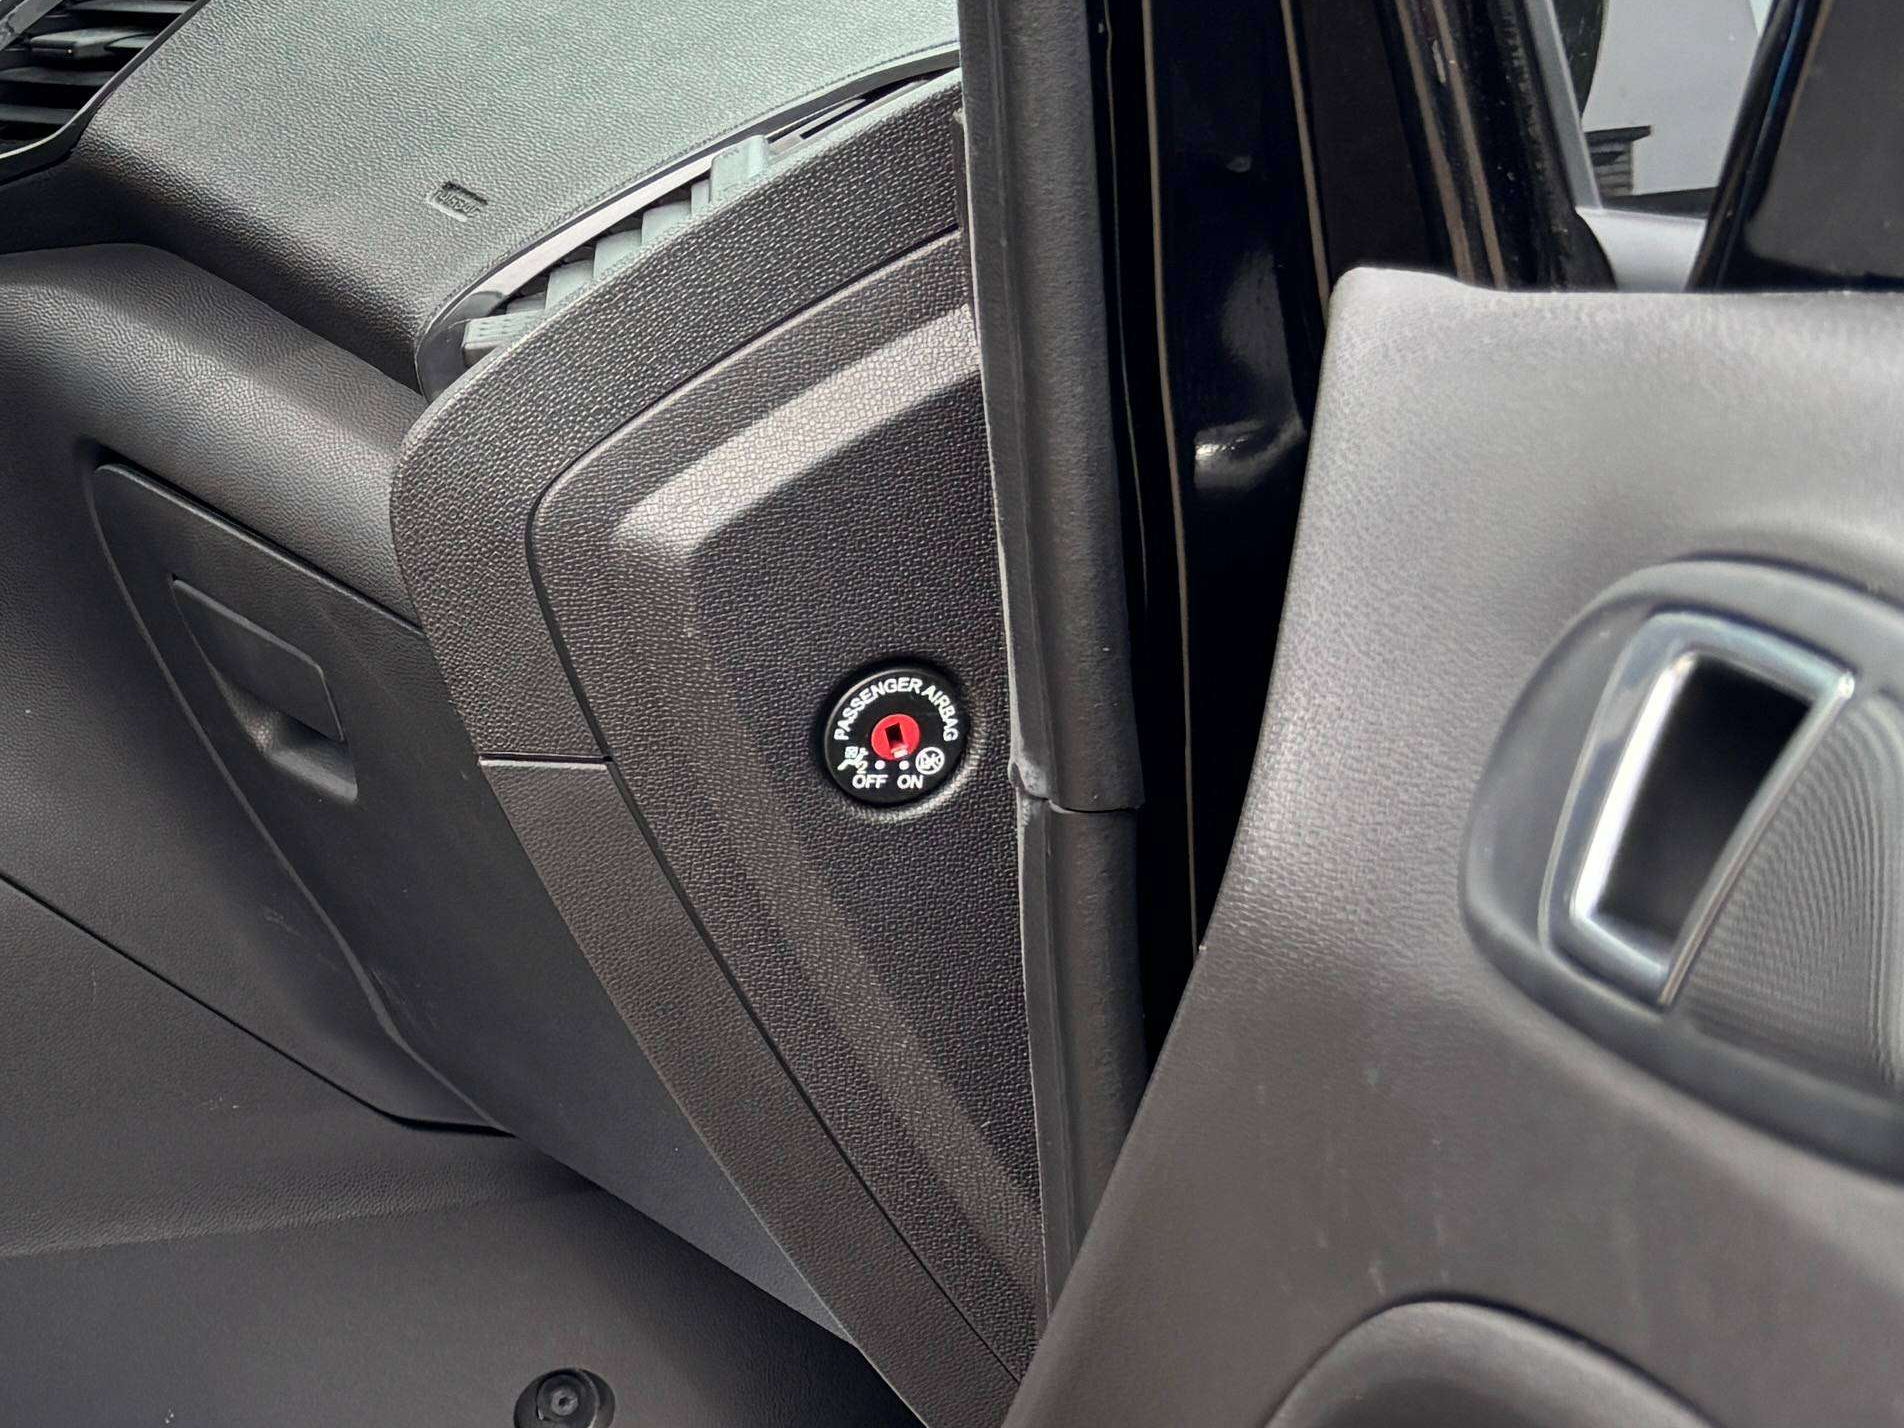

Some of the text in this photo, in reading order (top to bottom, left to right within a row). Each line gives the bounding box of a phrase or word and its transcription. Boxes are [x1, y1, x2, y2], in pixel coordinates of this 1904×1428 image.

[834, 677, 960, 742] PASSENGER AIRBAG
[852, 774, 924, 789] OFF ON
